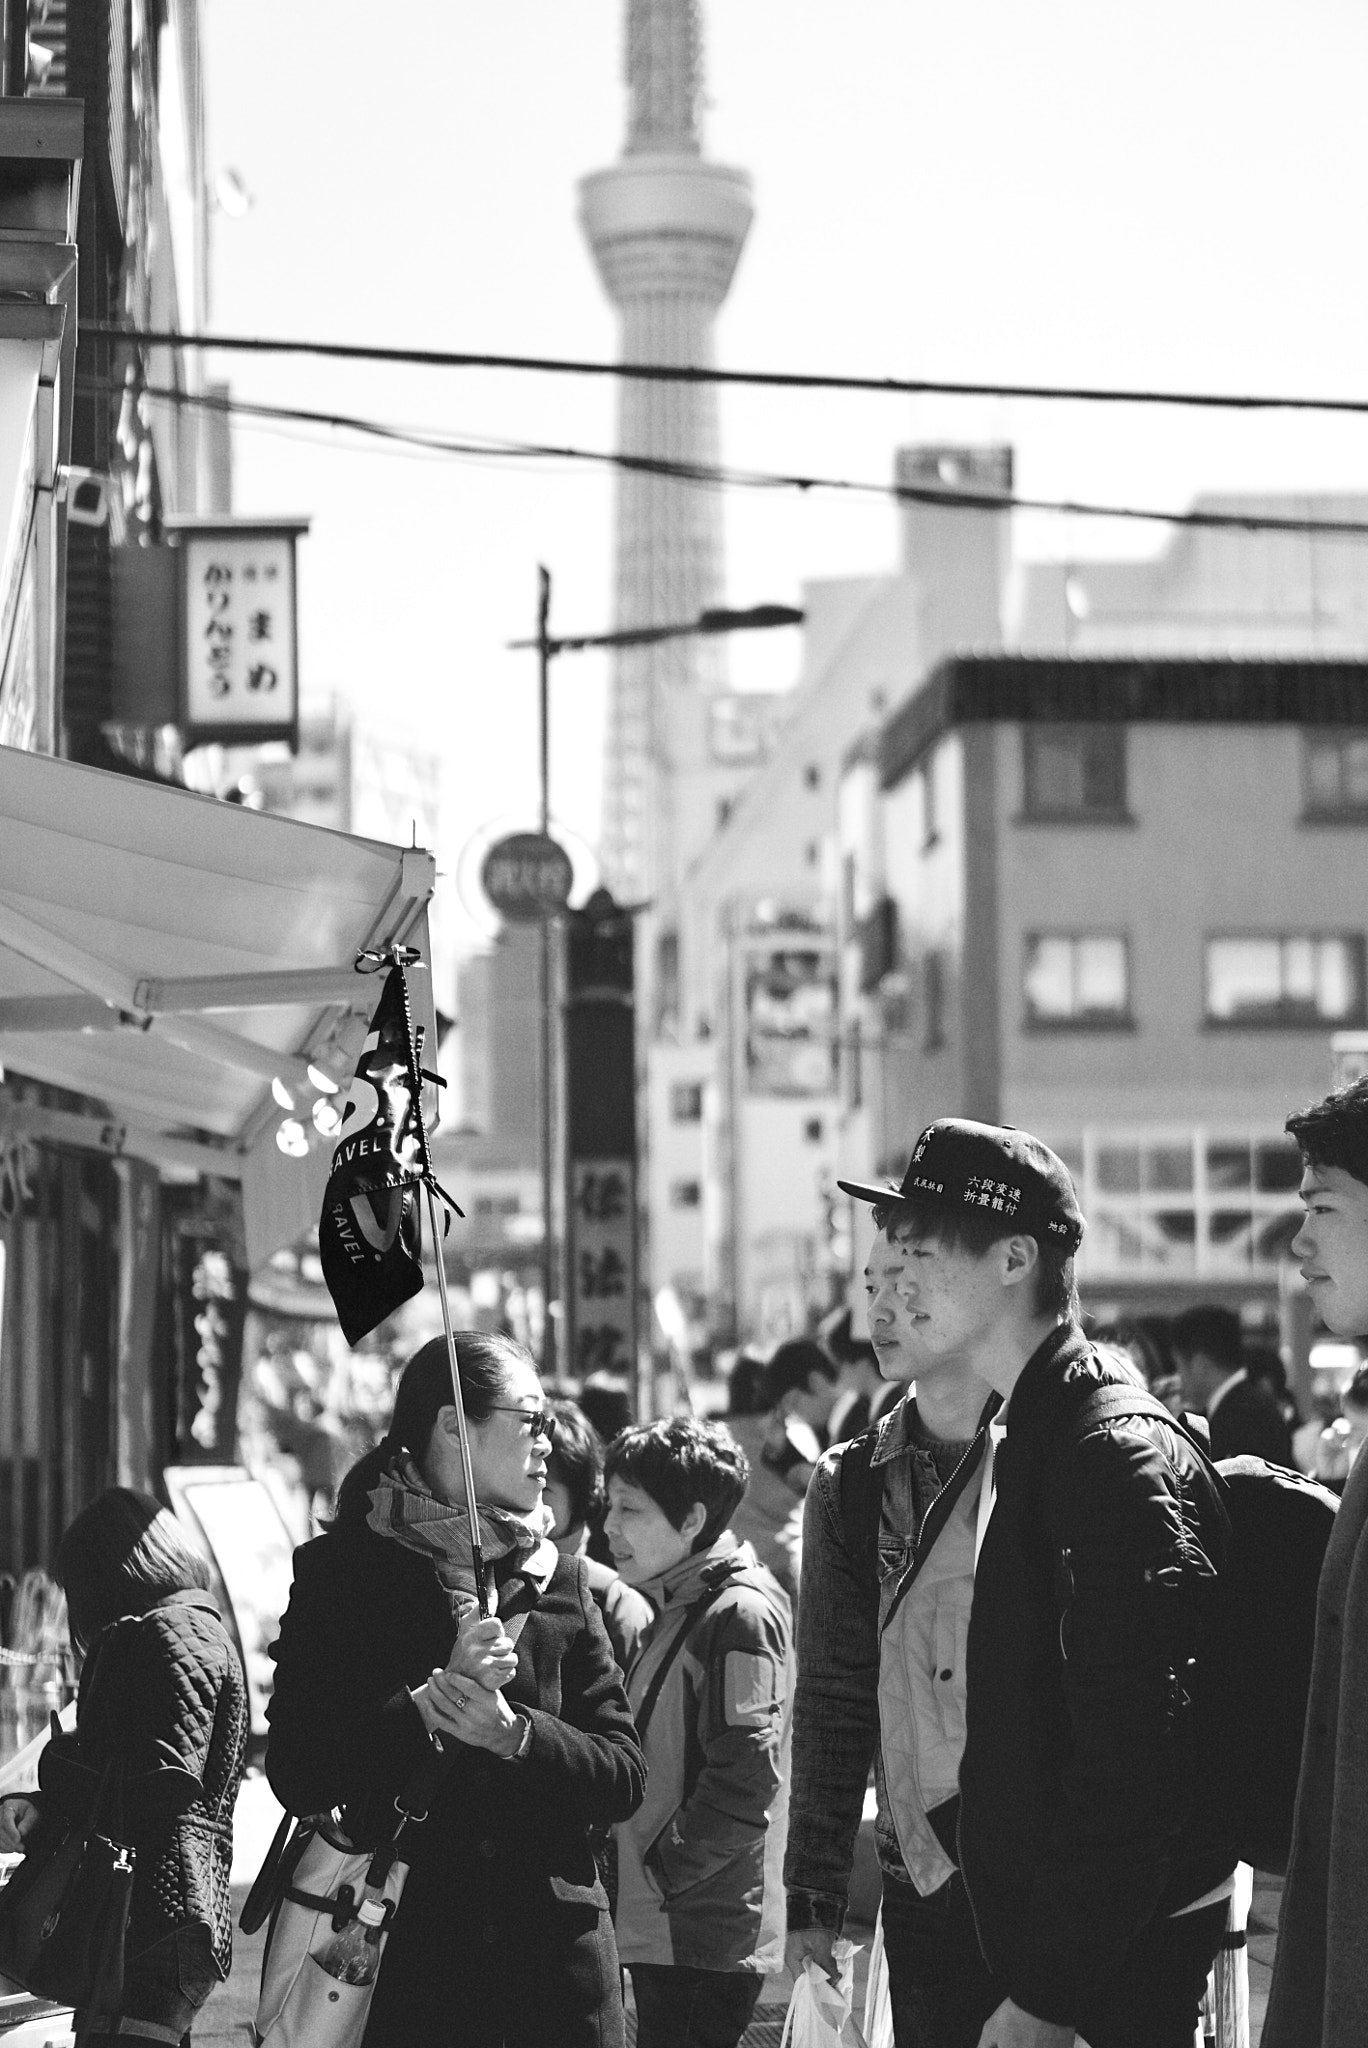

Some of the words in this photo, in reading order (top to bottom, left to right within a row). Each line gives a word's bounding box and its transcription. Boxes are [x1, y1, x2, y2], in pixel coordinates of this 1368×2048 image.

[250, 611, 278, 691] まめ
[328, 1137, 383, 1179] AVEL
[967, 1175, 1022, 1203] 六段変速
